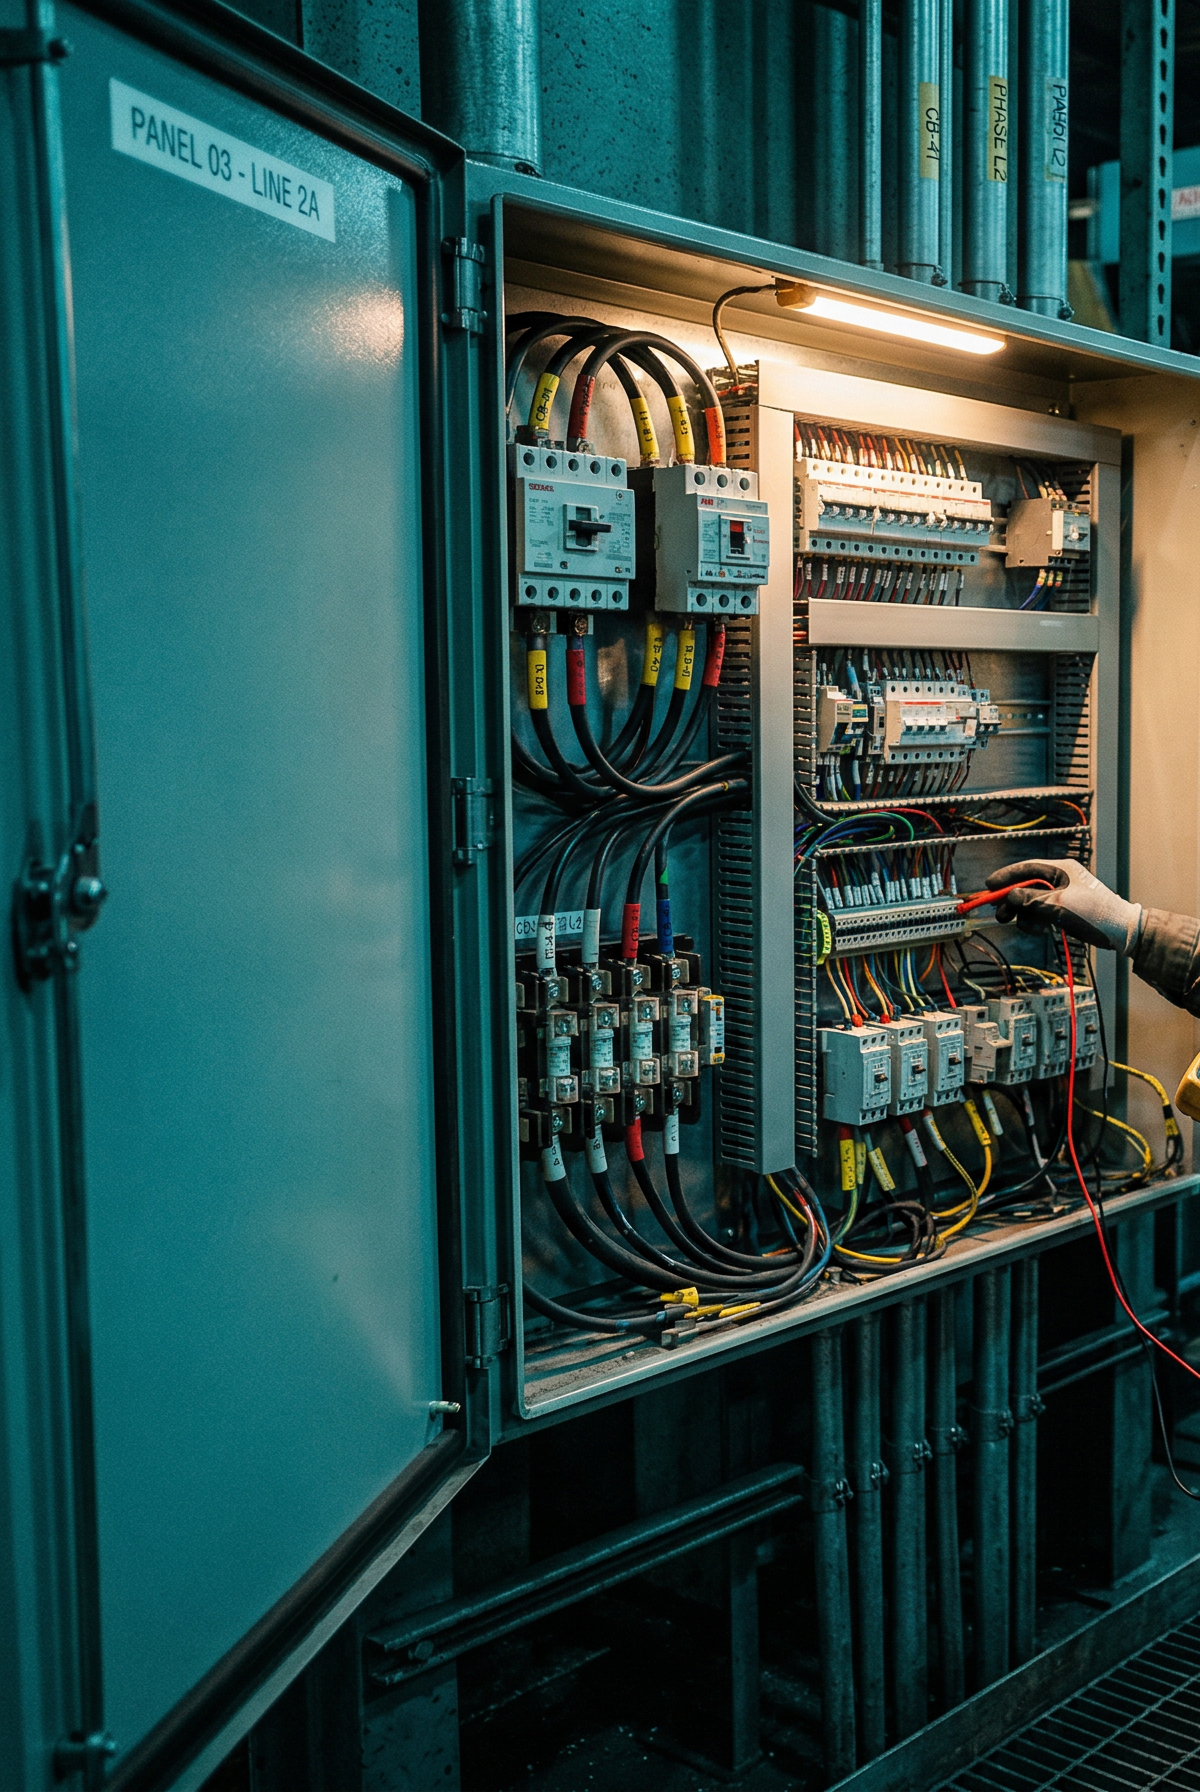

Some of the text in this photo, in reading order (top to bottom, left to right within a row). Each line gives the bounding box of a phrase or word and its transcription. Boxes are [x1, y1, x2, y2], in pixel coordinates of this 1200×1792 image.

[131, 105, 202, 169] PANEL
[208, 143, 231, 182] 03
[252, 161, 293, 208] LINE
[297, 184, 320, 221] 2A
[993, 83, 1007, 182] PHASE L2
